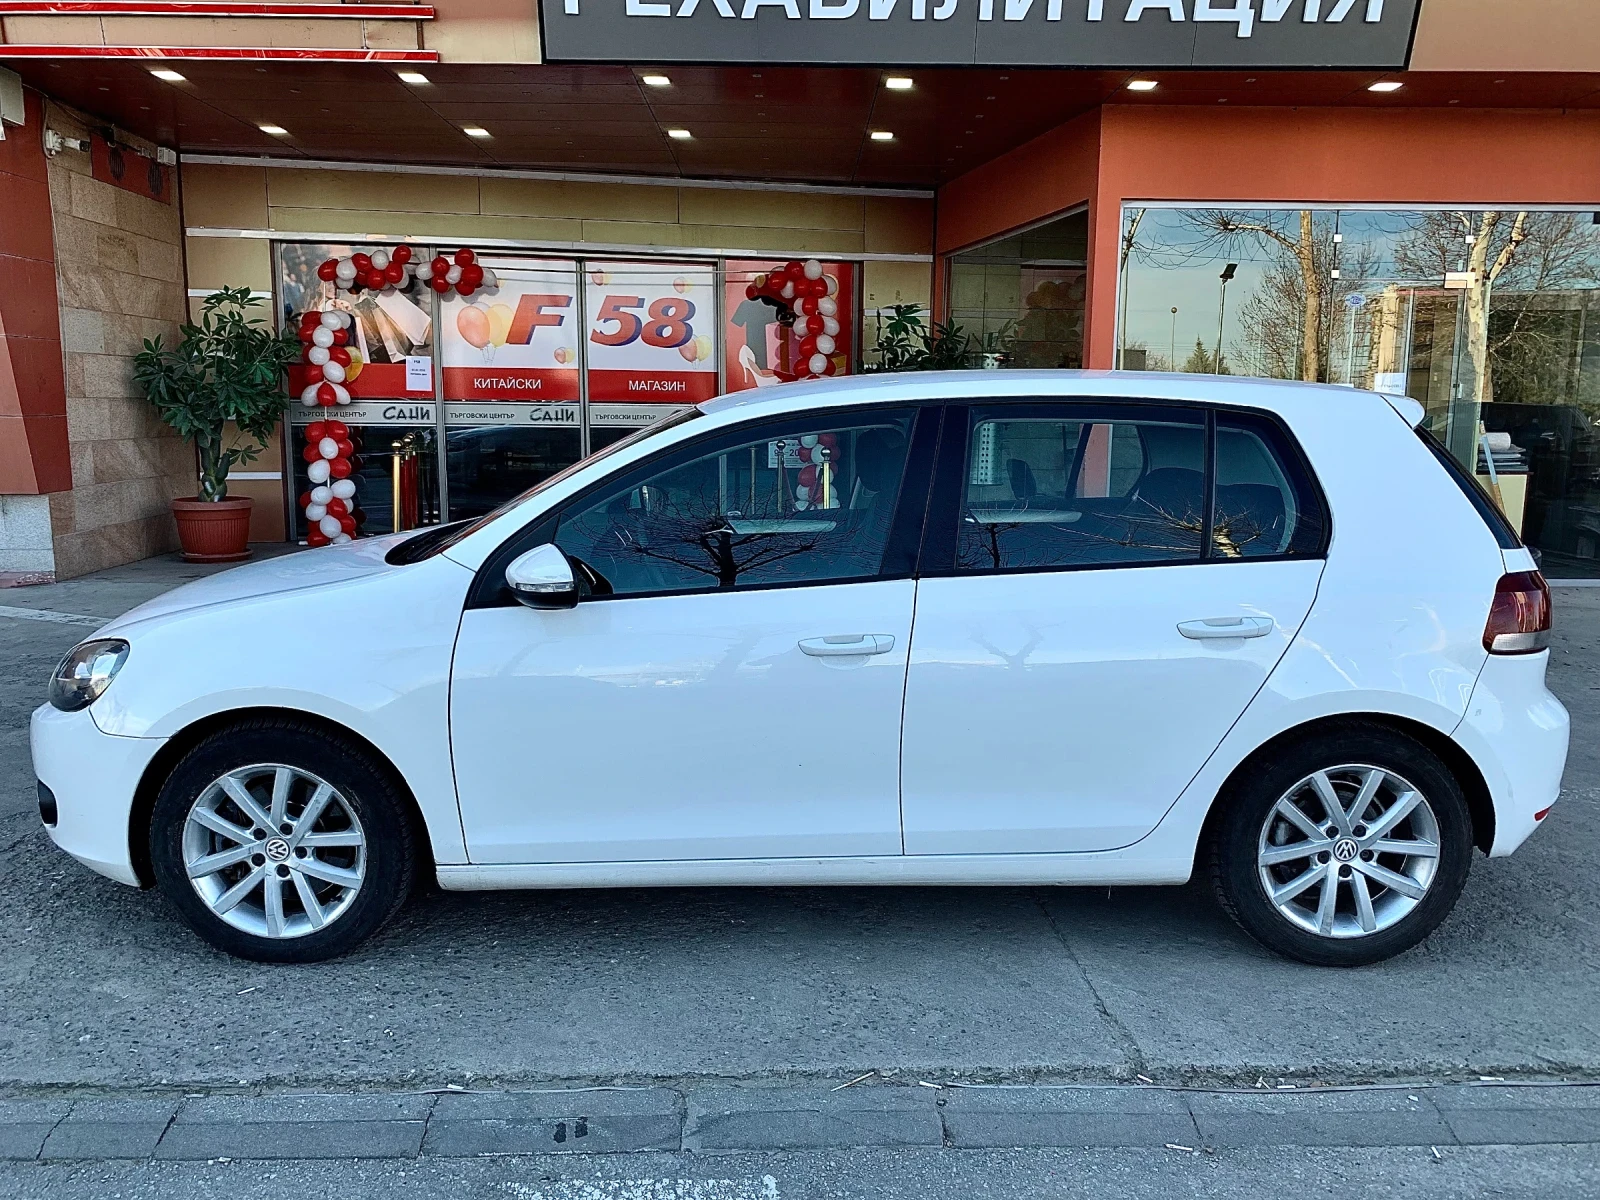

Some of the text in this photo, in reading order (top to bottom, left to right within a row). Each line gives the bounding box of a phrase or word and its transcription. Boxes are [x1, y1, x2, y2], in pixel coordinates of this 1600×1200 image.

[505, 294, 696, 348] F 58
[474, 377, 686, 392] КИТАЙСКИ МАГАЗИН
